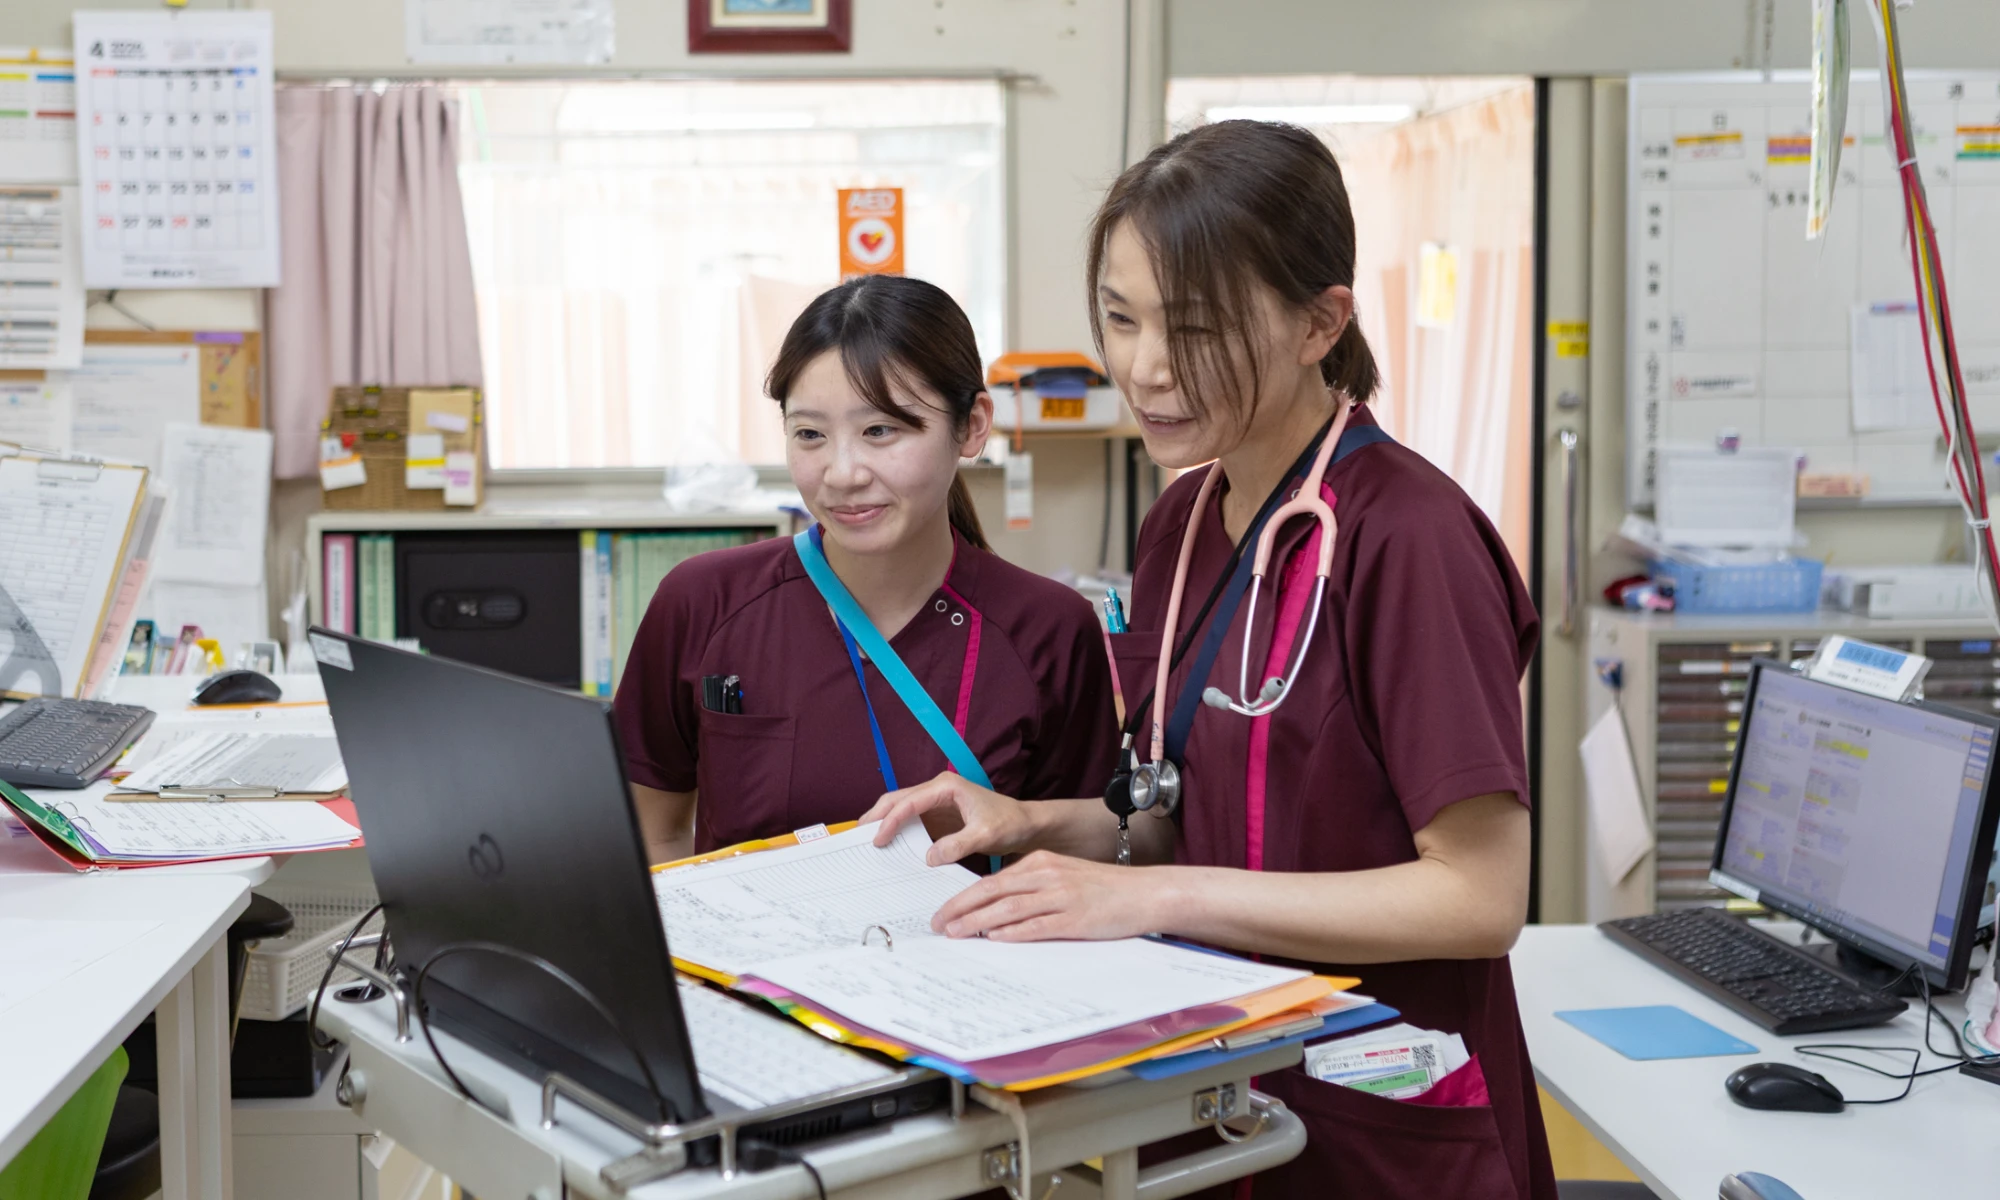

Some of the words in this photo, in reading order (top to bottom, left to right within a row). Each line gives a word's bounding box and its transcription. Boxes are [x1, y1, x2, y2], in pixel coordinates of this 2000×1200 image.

[90, 41, 104, 59] 4
[214, 147, 230, 159] 17
[848, 191, 896, 210] AED
[123, 216, 139, 228] 27
